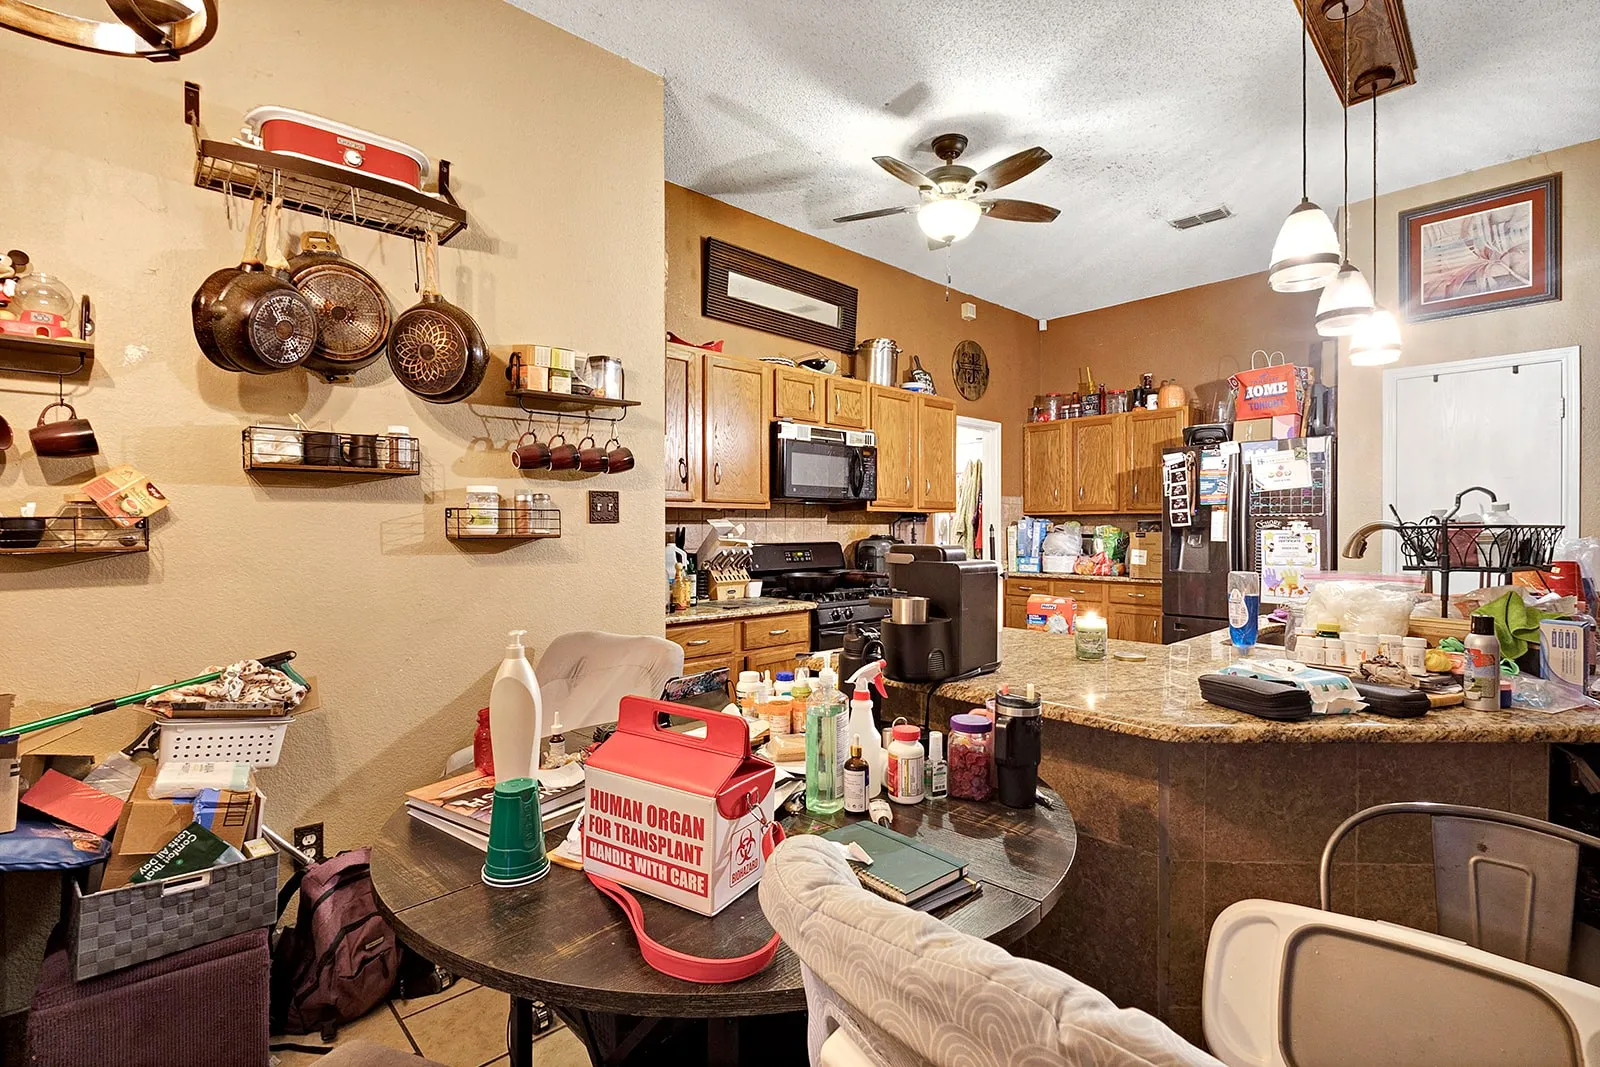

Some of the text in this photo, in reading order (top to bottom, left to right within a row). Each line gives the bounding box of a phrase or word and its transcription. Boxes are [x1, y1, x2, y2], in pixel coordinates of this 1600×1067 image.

[589, 813, 704, 867] FOR TRANSPLANT
[590, 787, 705, 842] HUMAN ORGAN
[139, 830, 191, 875] Lasts All Day
[144, 833, 198, 881] Comfort That
[589, 840, 705, 894] HANDLE WITH CARE
[731, 857, 759, 884] BIOHAZARD
